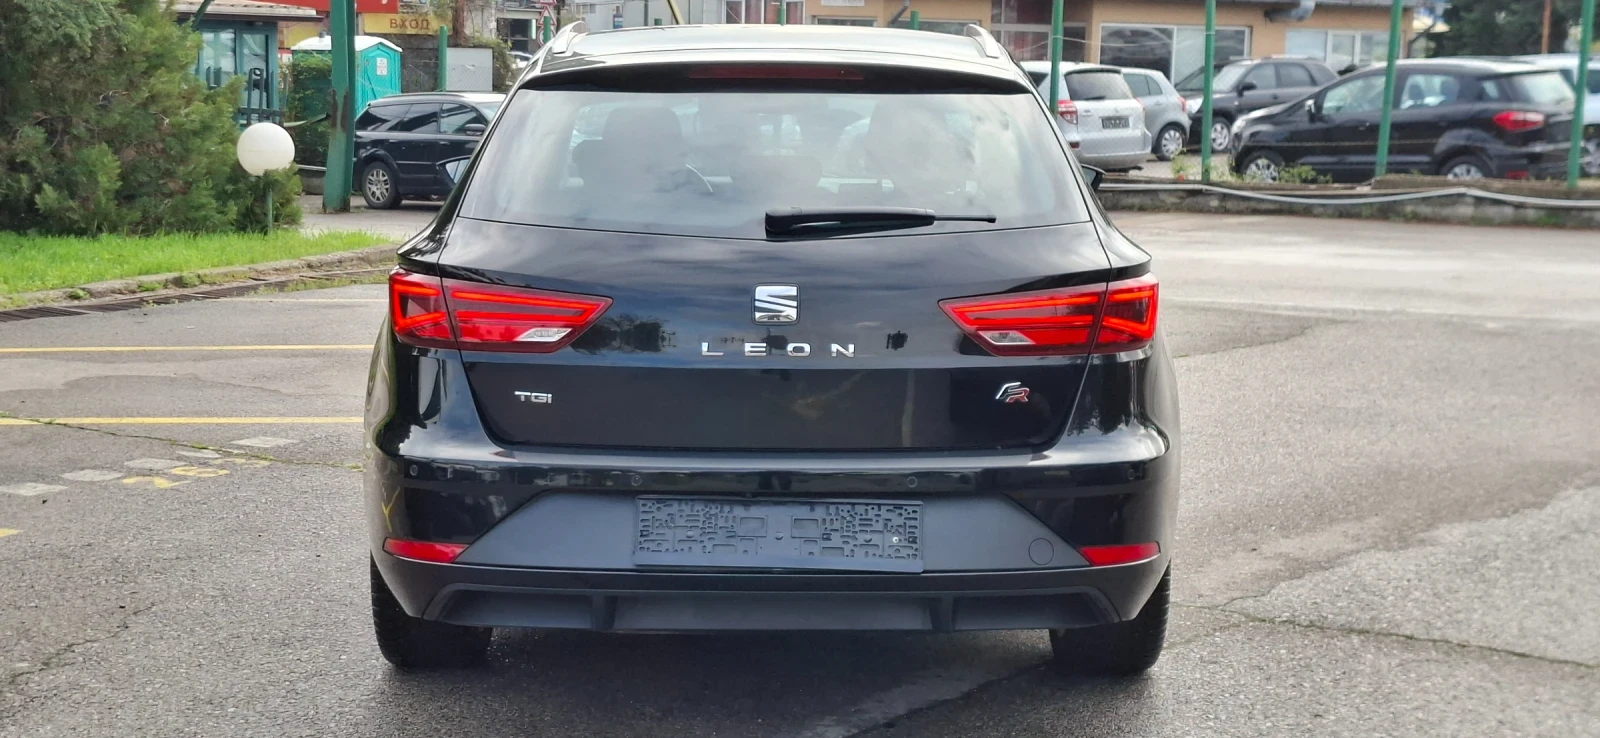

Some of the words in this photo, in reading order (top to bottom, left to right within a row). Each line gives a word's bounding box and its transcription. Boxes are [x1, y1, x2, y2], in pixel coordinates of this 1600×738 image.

[390, 18, 430, 30] ВХОД
[701, 342, 855, 358] LEON
[514, 391, 552, 403] TGI
[995, 381, 1030, 403] FR
